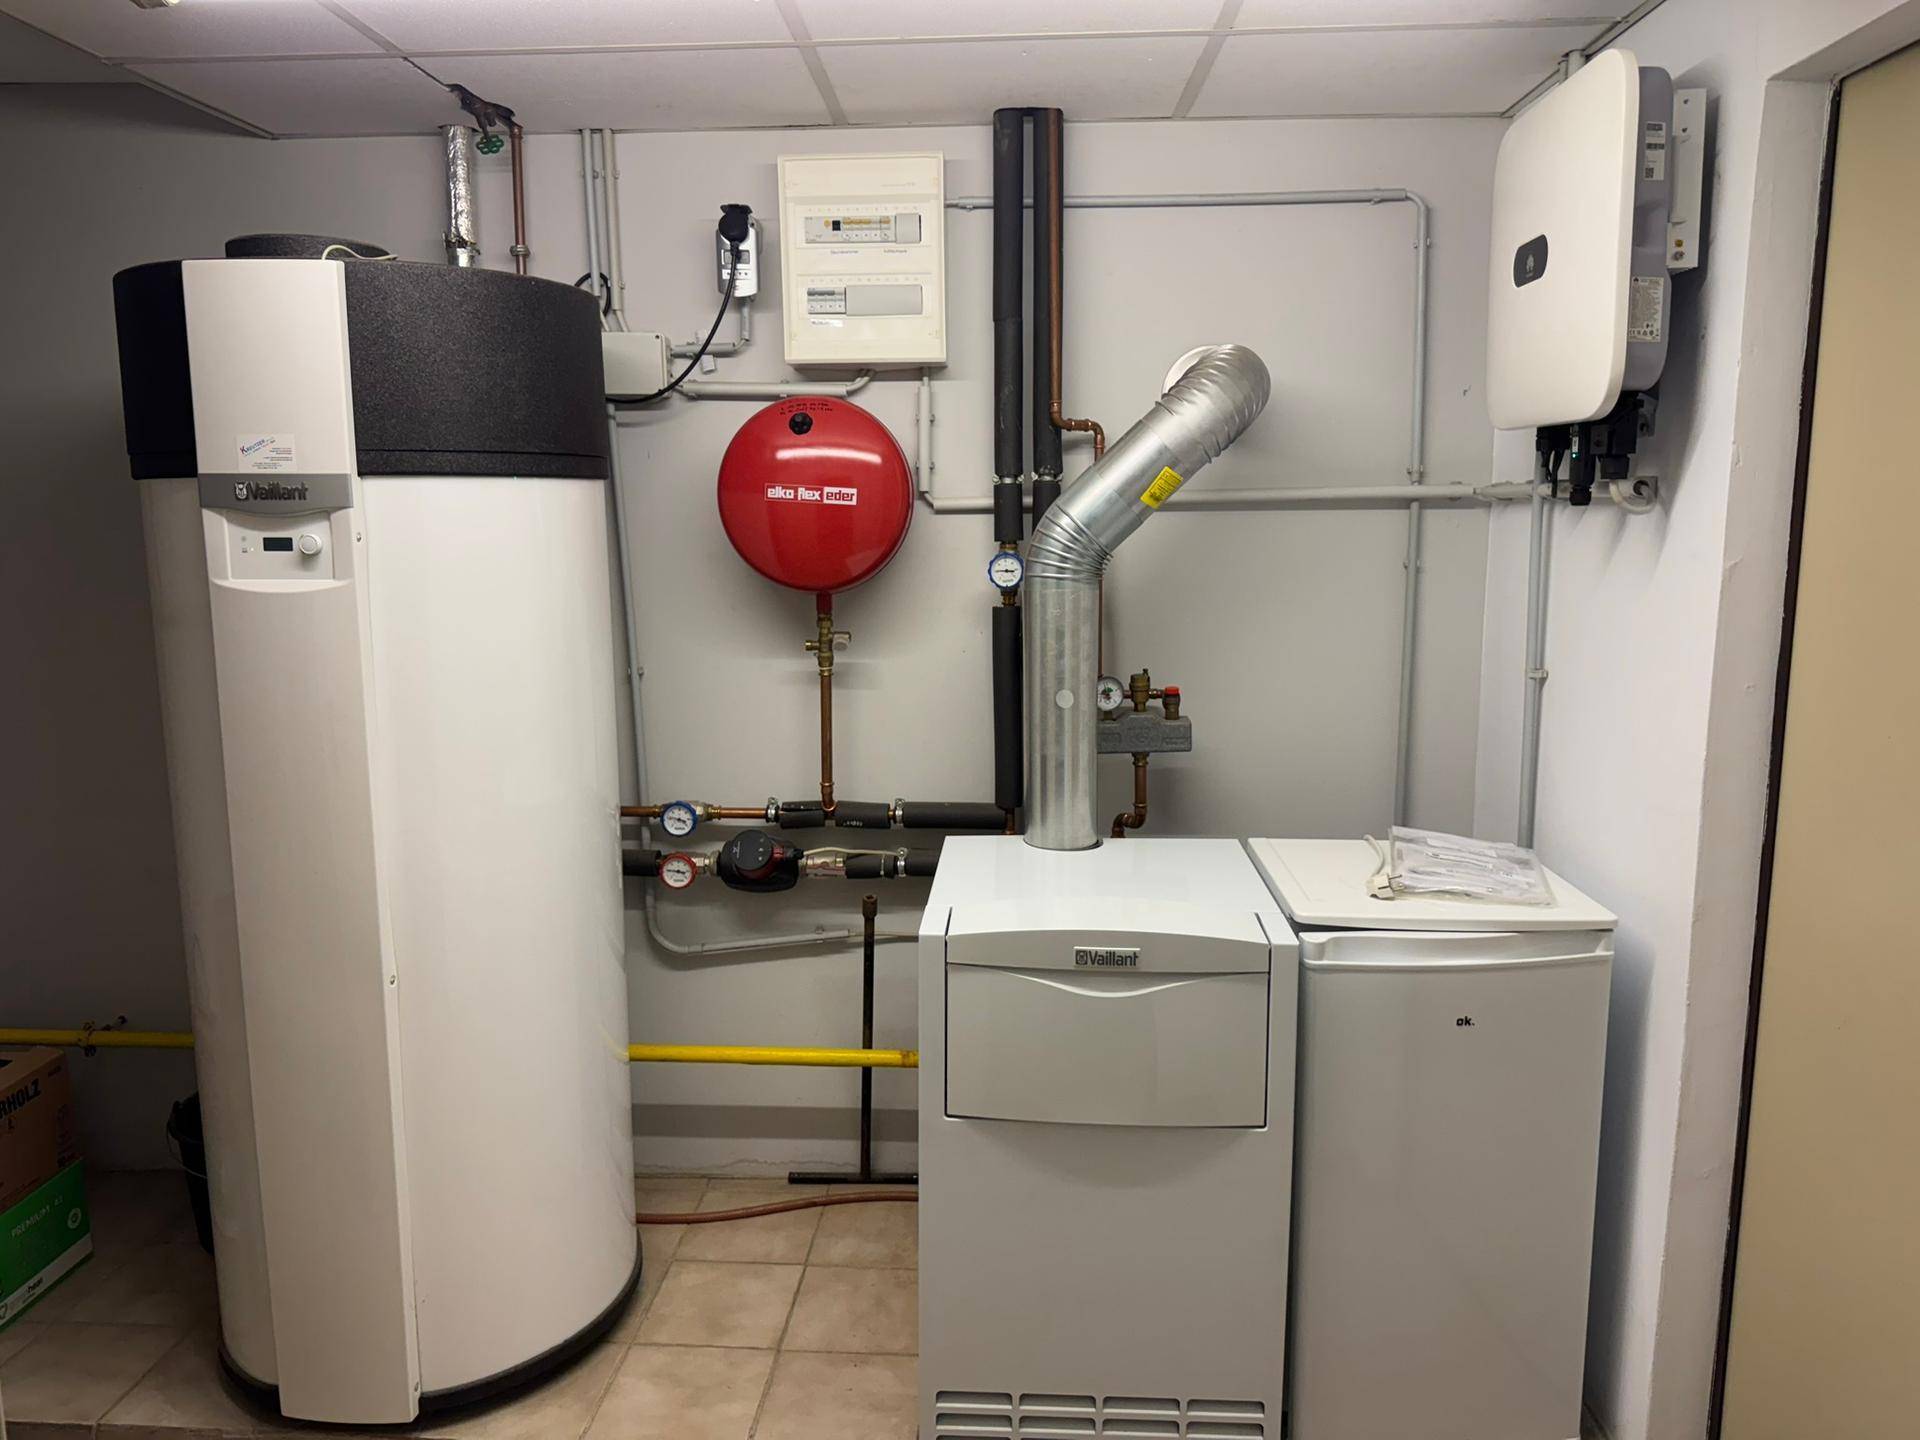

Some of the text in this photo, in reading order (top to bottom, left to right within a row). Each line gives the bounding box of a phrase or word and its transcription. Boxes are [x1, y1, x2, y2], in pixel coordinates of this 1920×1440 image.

[248, 481, 309, 501] Vaillant
[825, 489, 855, 502] eder
[1088, 950, 1139, 967] Vaillant
